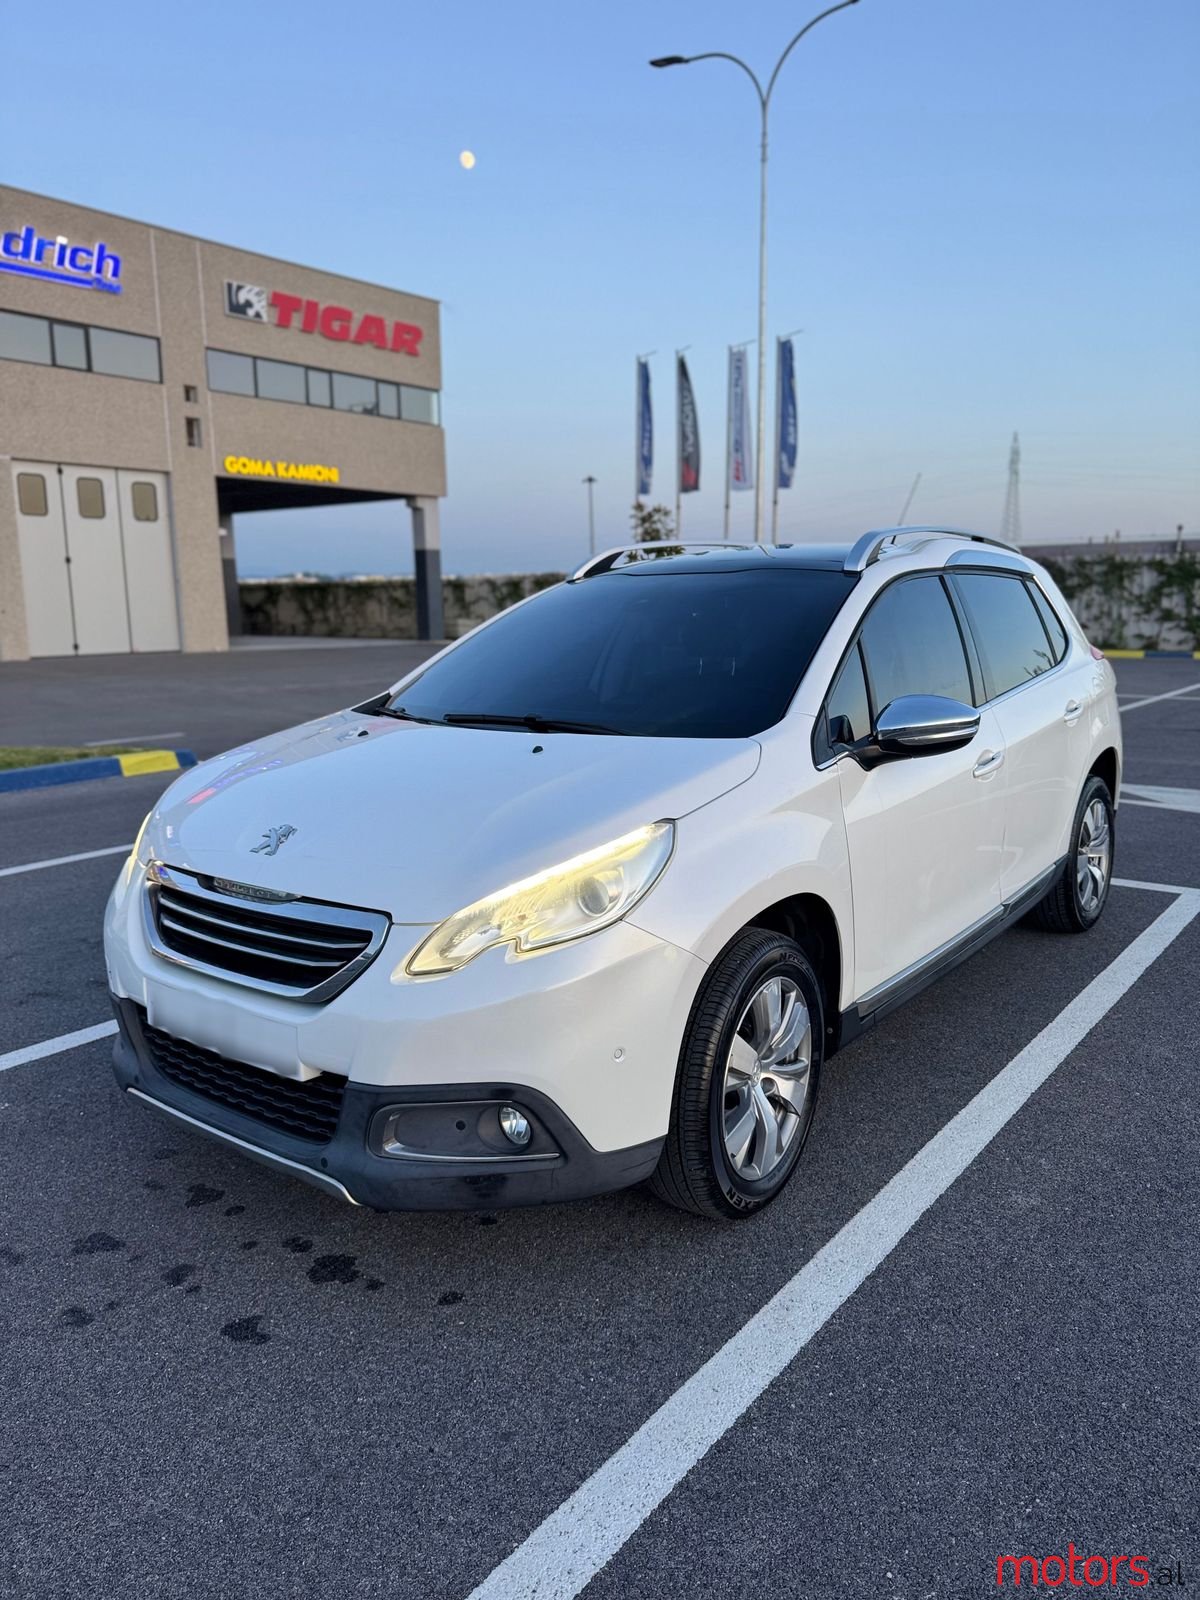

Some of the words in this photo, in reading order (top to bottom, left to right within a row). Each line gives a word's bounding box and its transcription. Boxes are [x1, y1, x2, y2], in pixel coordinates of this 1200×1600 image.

[1, 225, 122, 279] drich
[271, 290, 423, 357] TIGAR
[224, 456, 275, 477] GOMA
[726, 1185, 764, 1210] EXEN
